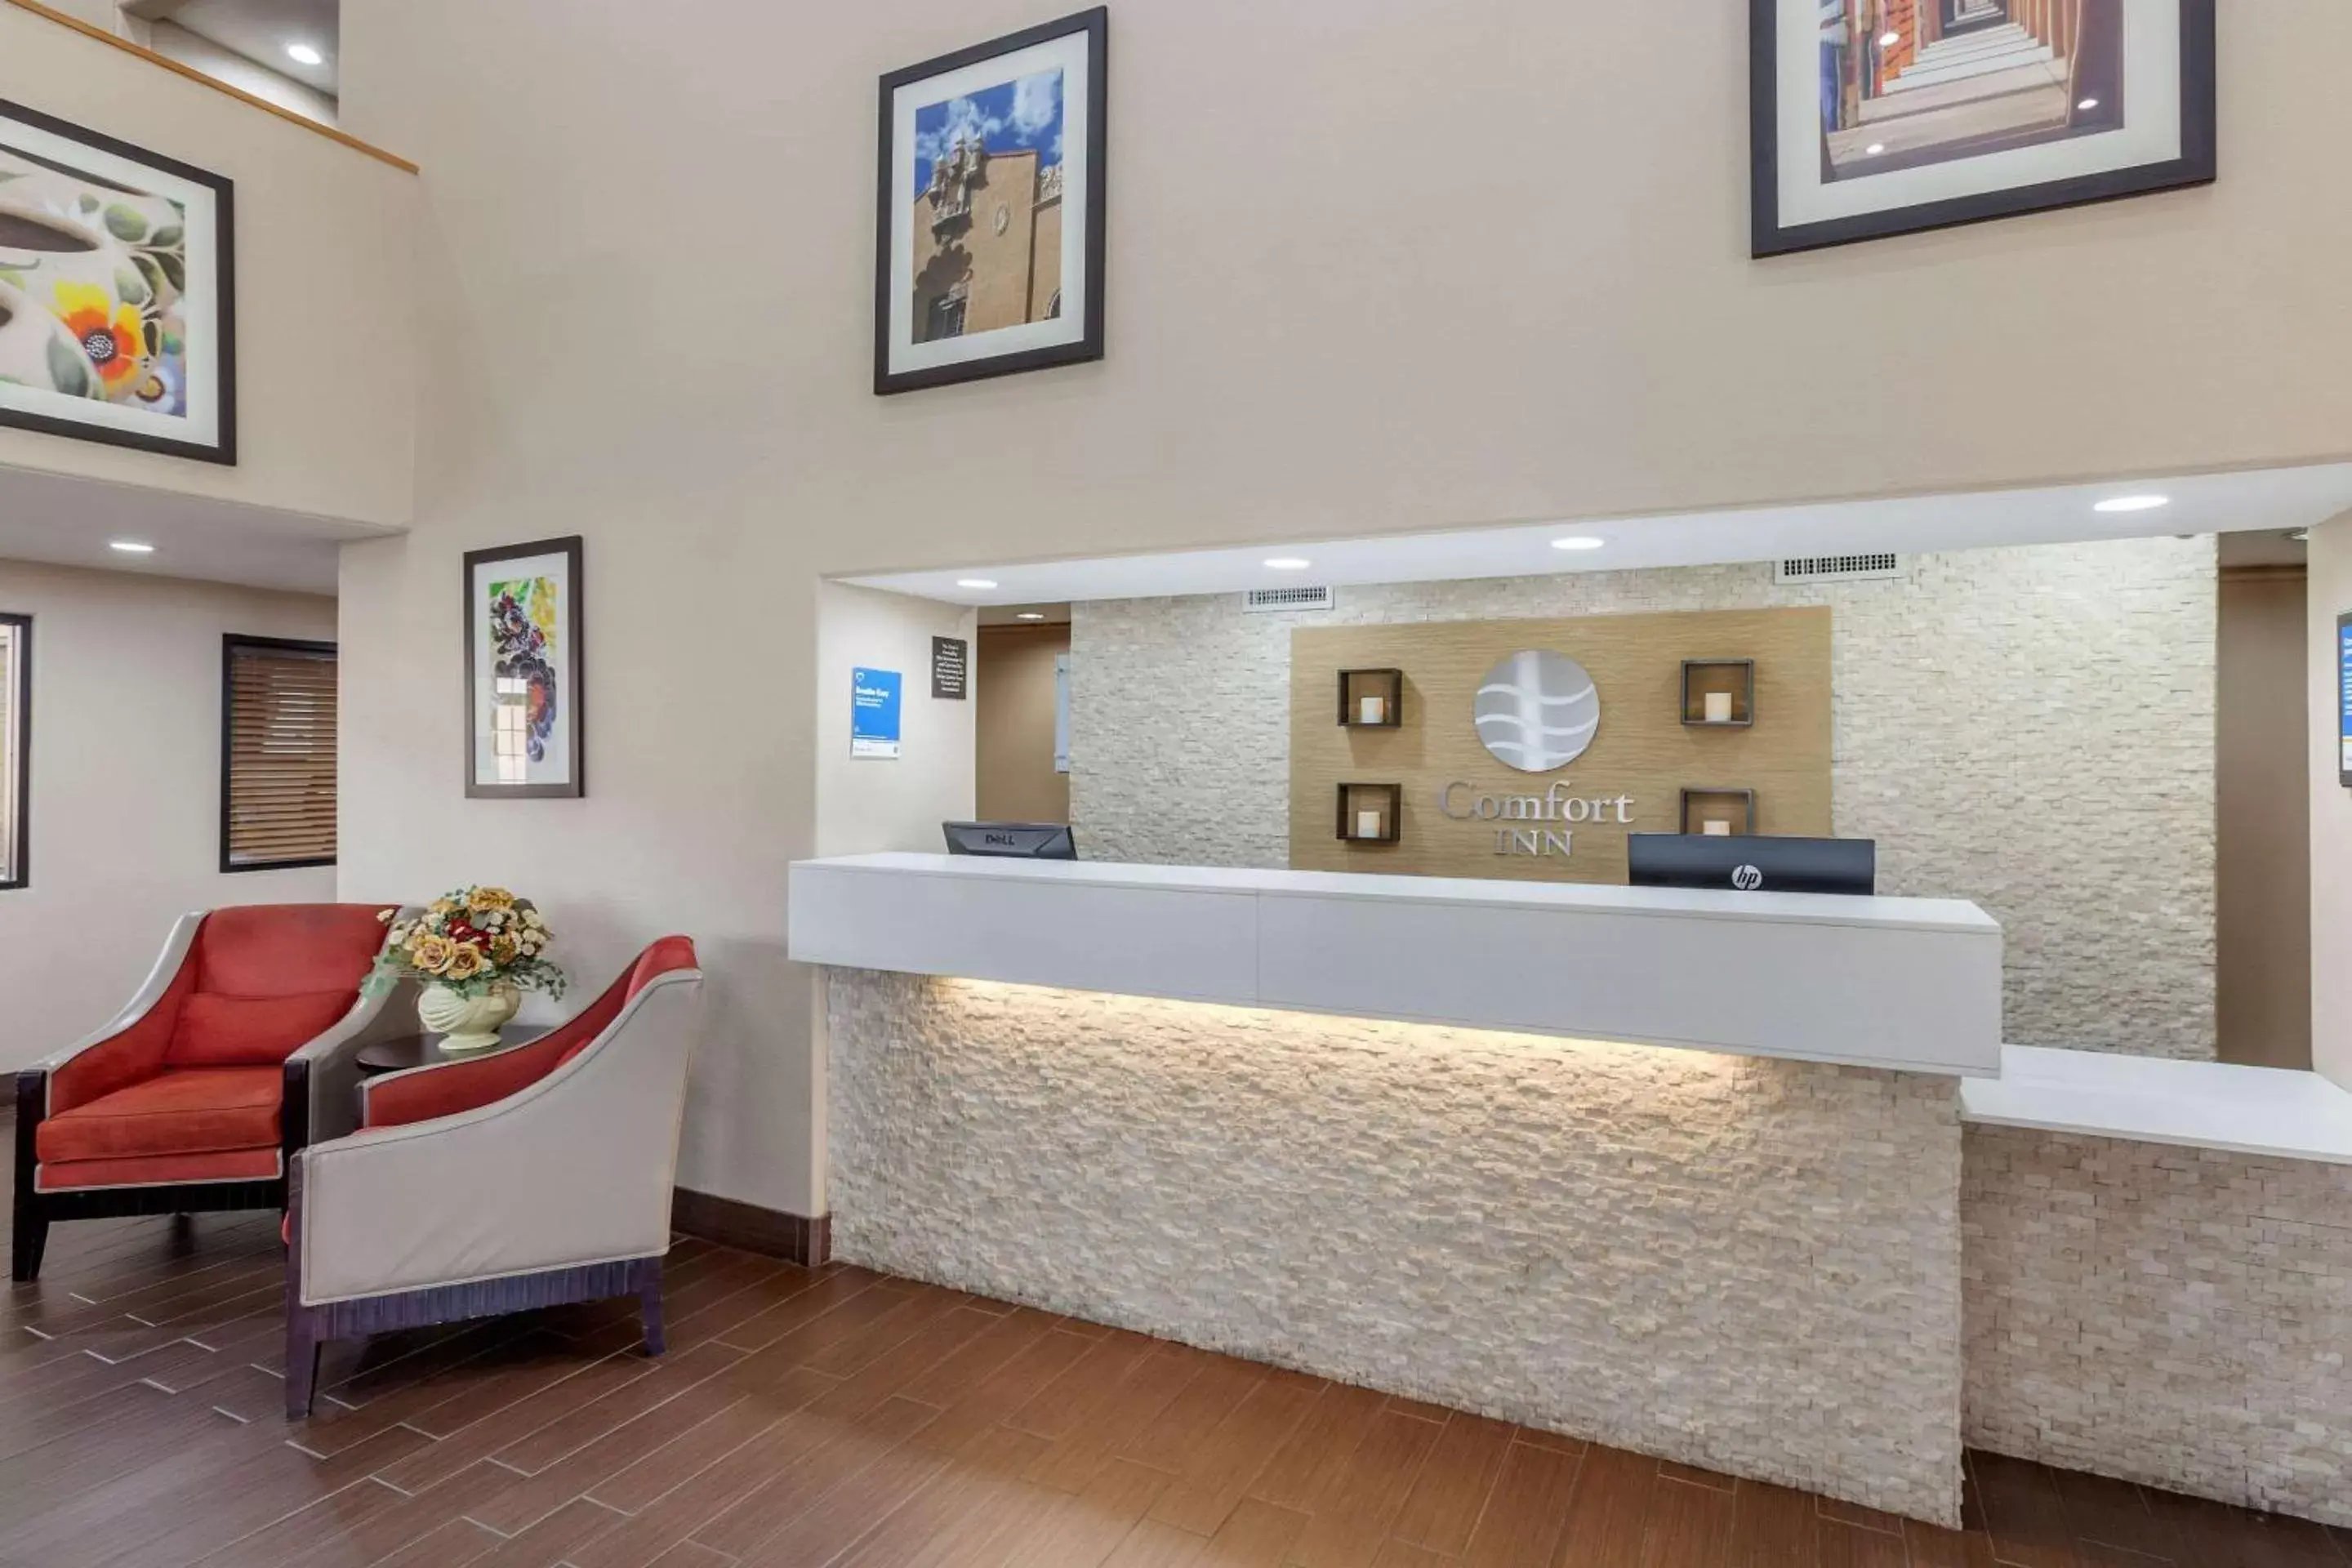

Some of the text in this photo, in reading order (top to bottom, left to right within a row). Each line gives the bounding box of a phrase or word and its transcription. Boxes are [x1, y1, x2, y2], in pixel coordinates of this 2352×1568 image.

[1438, 779, 1636, 824] Comfort
[1493, 827, 1574, 857] INN
[1735, 865, 1758, 890] hp
